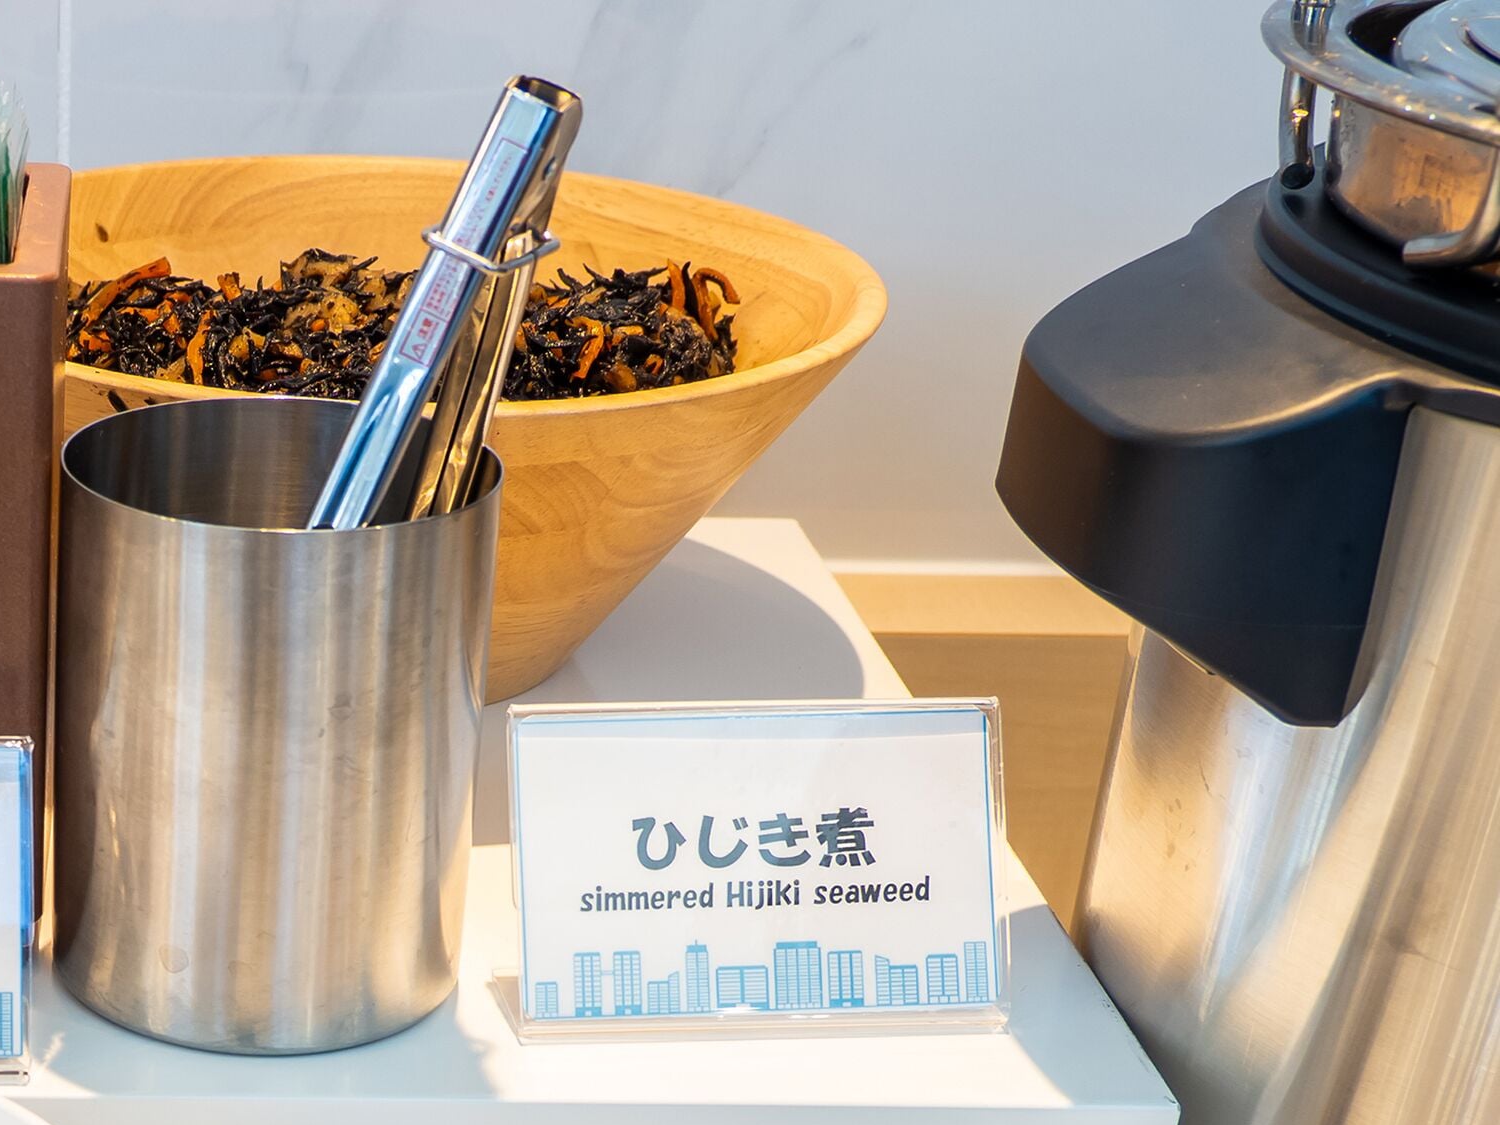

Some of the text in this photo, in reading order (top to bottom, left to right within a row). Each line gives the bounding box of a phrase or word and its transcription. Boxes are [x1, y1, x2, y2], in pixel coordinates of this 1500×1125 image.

[632, 807, 877, 870] ひじき煮
[580, 875, 930, 912] simmered Hijiki seaweed
